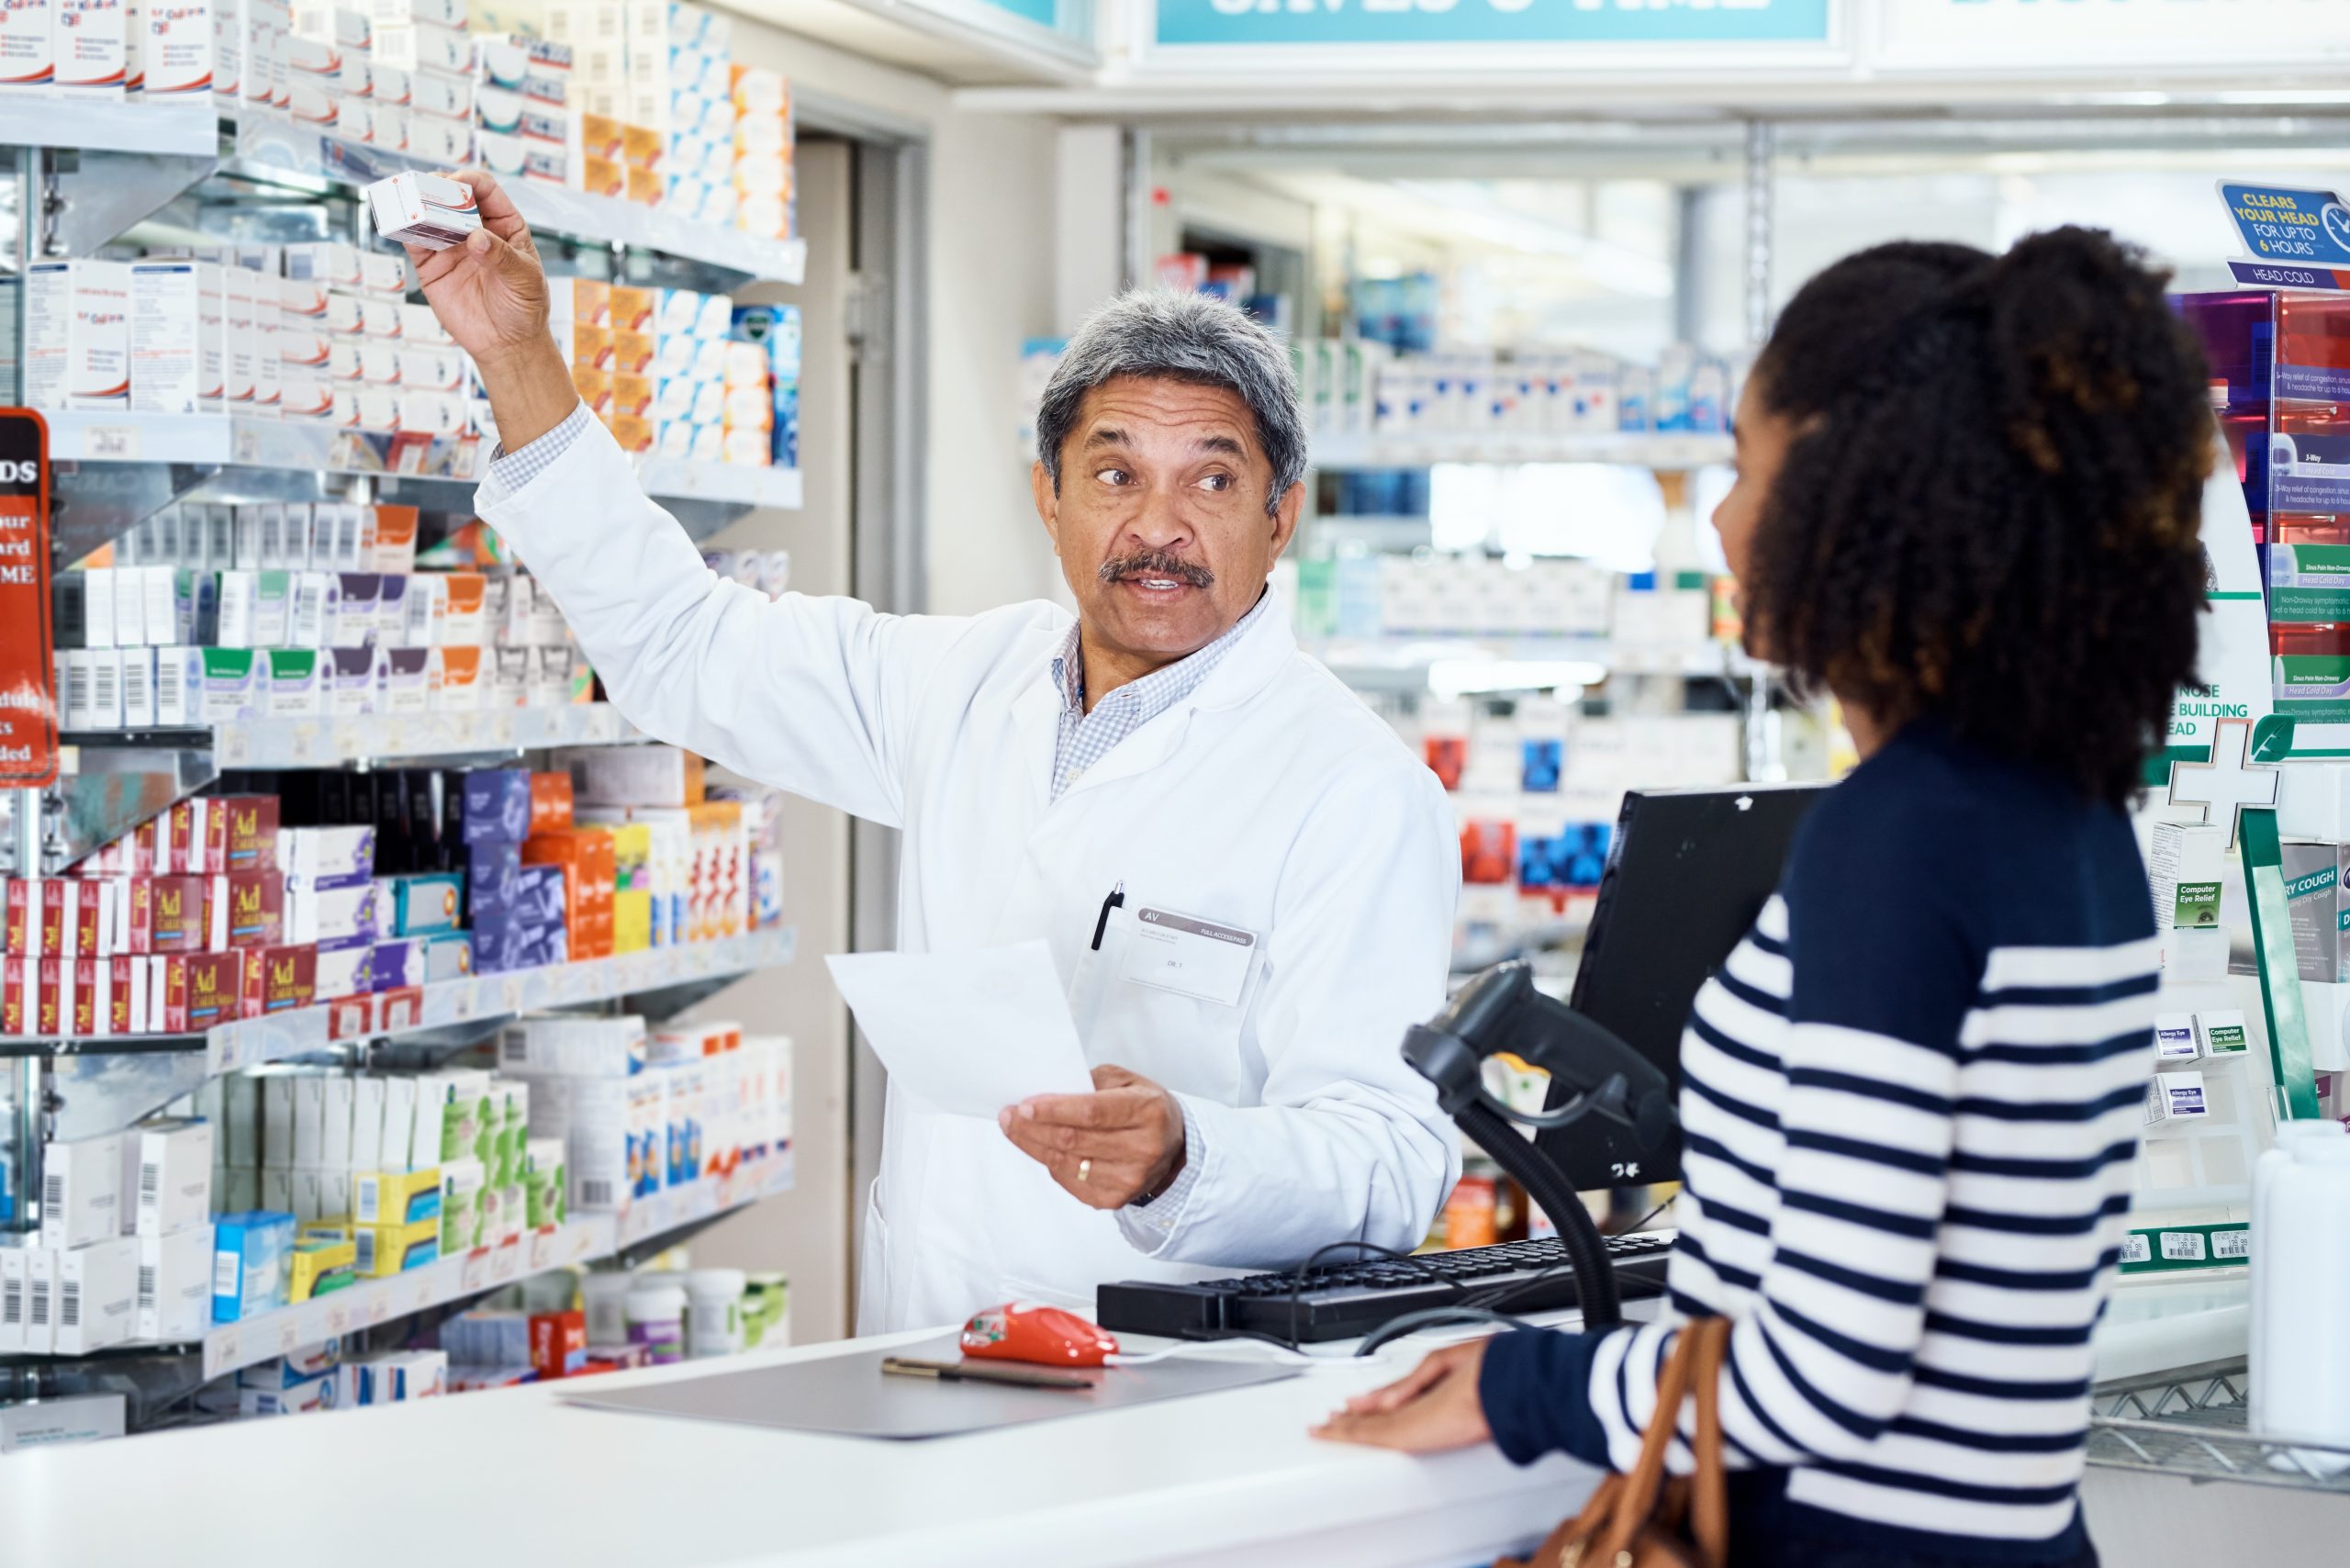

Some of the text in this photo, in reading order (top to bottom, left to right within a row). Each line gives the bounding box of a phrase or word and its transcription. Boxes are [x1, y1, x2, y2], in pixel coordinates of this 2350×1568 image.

[2243, 193, 2298, 210] CLEARS
[2233, 207, 2320, 227] YOUR HEAD
[2253, 223, 2281, 239] FOR
[2259, 239, 2314, 256] 6 HOURS
[2253, 268, 2315, 285] HEAD COLD
[0, 460, 38, 484] DS
[2305, 465, 2322, 476] Head
[2302, 576, 2319, 584] Head
[2333, 576, 2346, 587] Day
[2288, 606, 2304, 614] head
[2304, 606, 2318, 614] cold
[2179, 683, 2220, 699] NOSE
[2288, 686, 2333, 697] Head Cold Day
[2179, 703, 2248, 718] BUILDING
[2166, 722, 2197, 735] EAD
[2298, 870, 2334, 892] COUGH
[2180, 885, 2216, 894] Computer
[2179, 893, 2215, 904] Eye Relief
[1144, 911, 1159, 923] AV
[2177, 1029, 2186, 1037] Eye
[2210, 1027, 2240, 1036] Computer
[2211, 1034, 2242, 1044] Eye Relief
